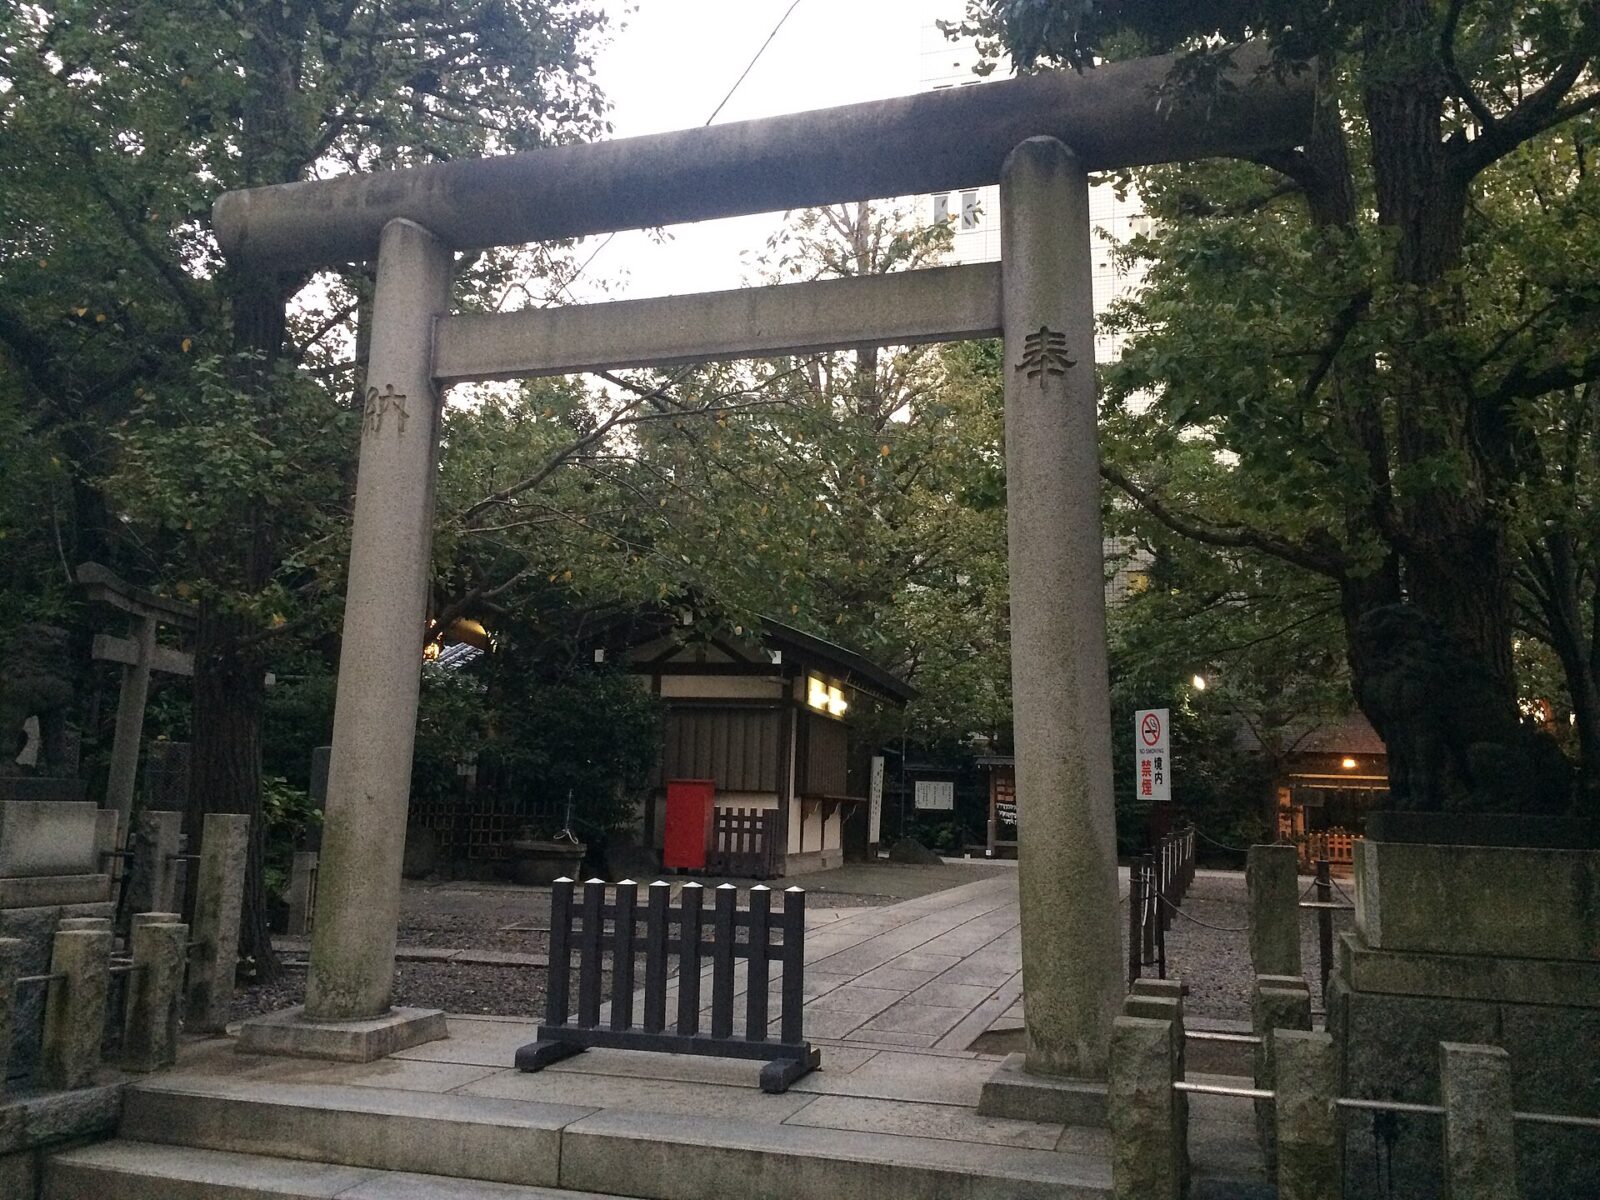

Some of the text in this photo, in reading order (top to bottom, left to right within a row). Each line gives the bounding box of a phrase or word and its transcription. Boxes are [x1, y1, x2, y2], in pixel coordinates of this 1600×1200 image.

[1014, 325, 1078, 389] 奉
[363, 383, 410, 435] 納
[1141, 759, 1152, 796] 禁煙
[1154, 756, 1163, 785] 境内
